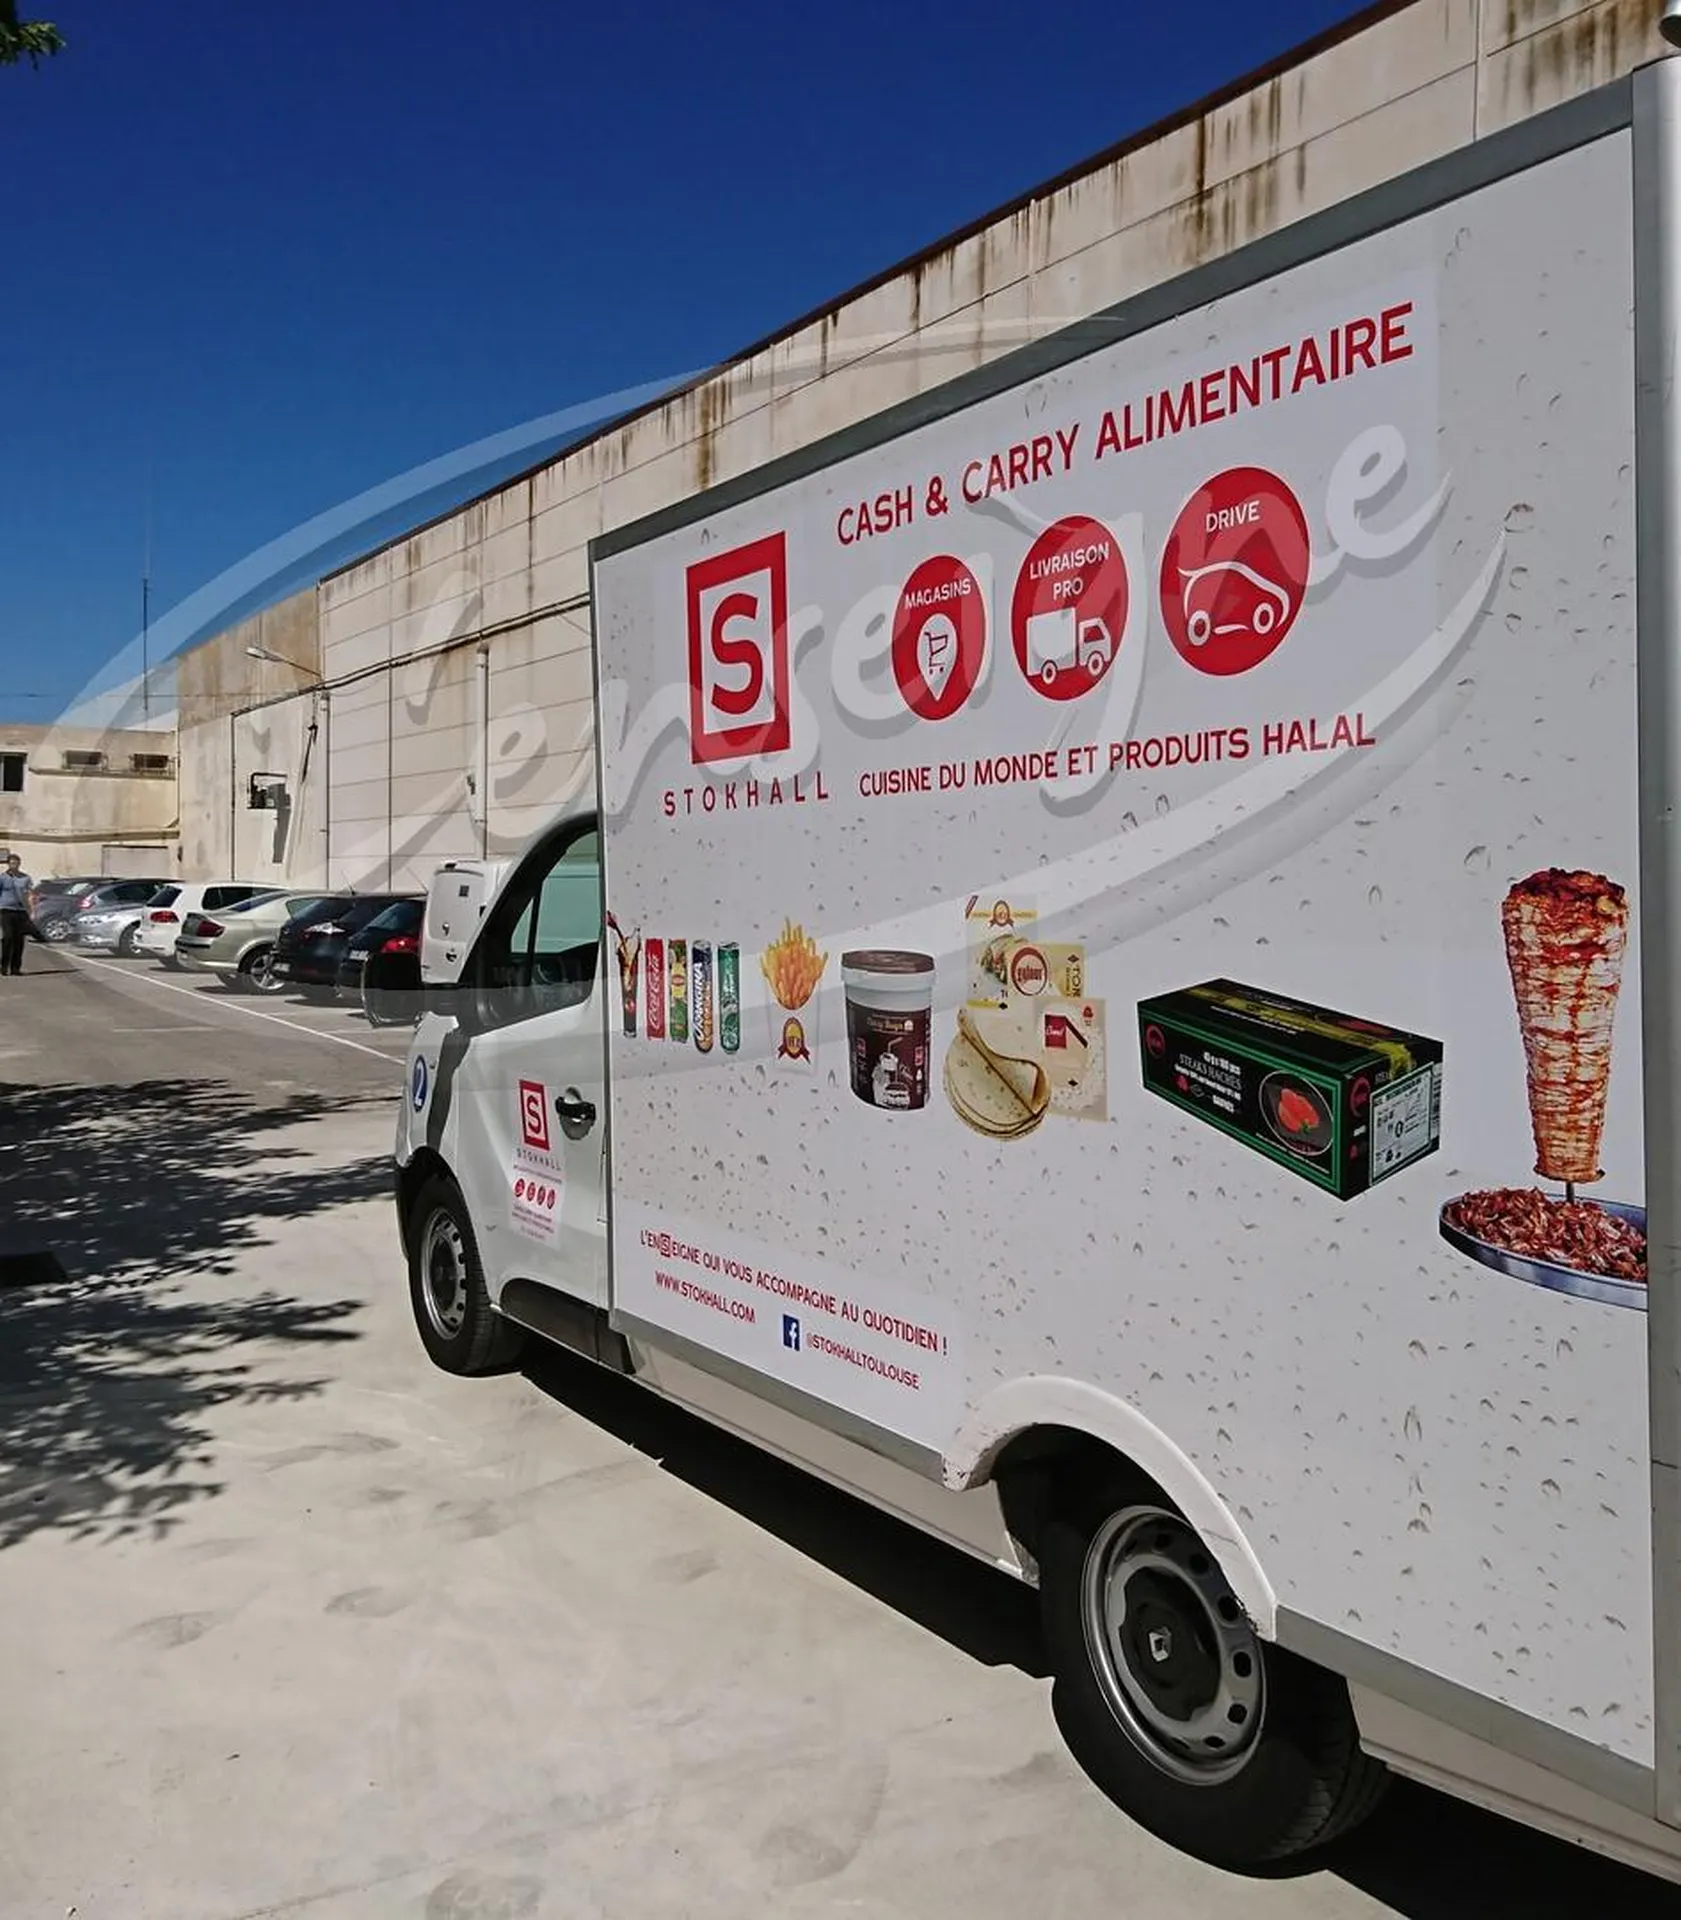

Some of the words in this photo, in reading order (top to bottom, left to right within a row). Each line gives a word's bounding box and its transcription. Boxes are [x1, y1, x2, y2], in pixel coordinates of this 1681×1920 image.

[837, 484, 913, 546] CASH
[925, 475, 949, 517] &
[961, 422, 1080, 504] CARRY
[1095, 302, 1415, 462] ALIMENTAIRE
[1205, 500, 1261, 532] DRIVE
[1029, 542, 1110, 580] LIVRAISON
[905, 577, 971, 610] MAGASINS
[1052, 576, 1083, 601] PRO
[859, 766, 931, 797] CUISINE
[939, 761, 966, 790] DU
[974, 750, 1058, 787] MONDE
[1068, 746, 1099, 776] ET
[1109, 727, 1250, 773] PRODUITS
[1262, 712, 1376, 756] HALAL
[663, 770, 830, 817] STOKHALL
[655, 1270, 756, 1324] WWW.STOKHALL.COM
[703, 1252, 721, 1272] QUI
[723, 1257, 753, 1283] VOUS
[756, 1270, 837, 1315] ACCOMPAGNE
[841, 1301, 859, 1322] AU
[863, 1309, 938, 1352] QUOTIDIEN
